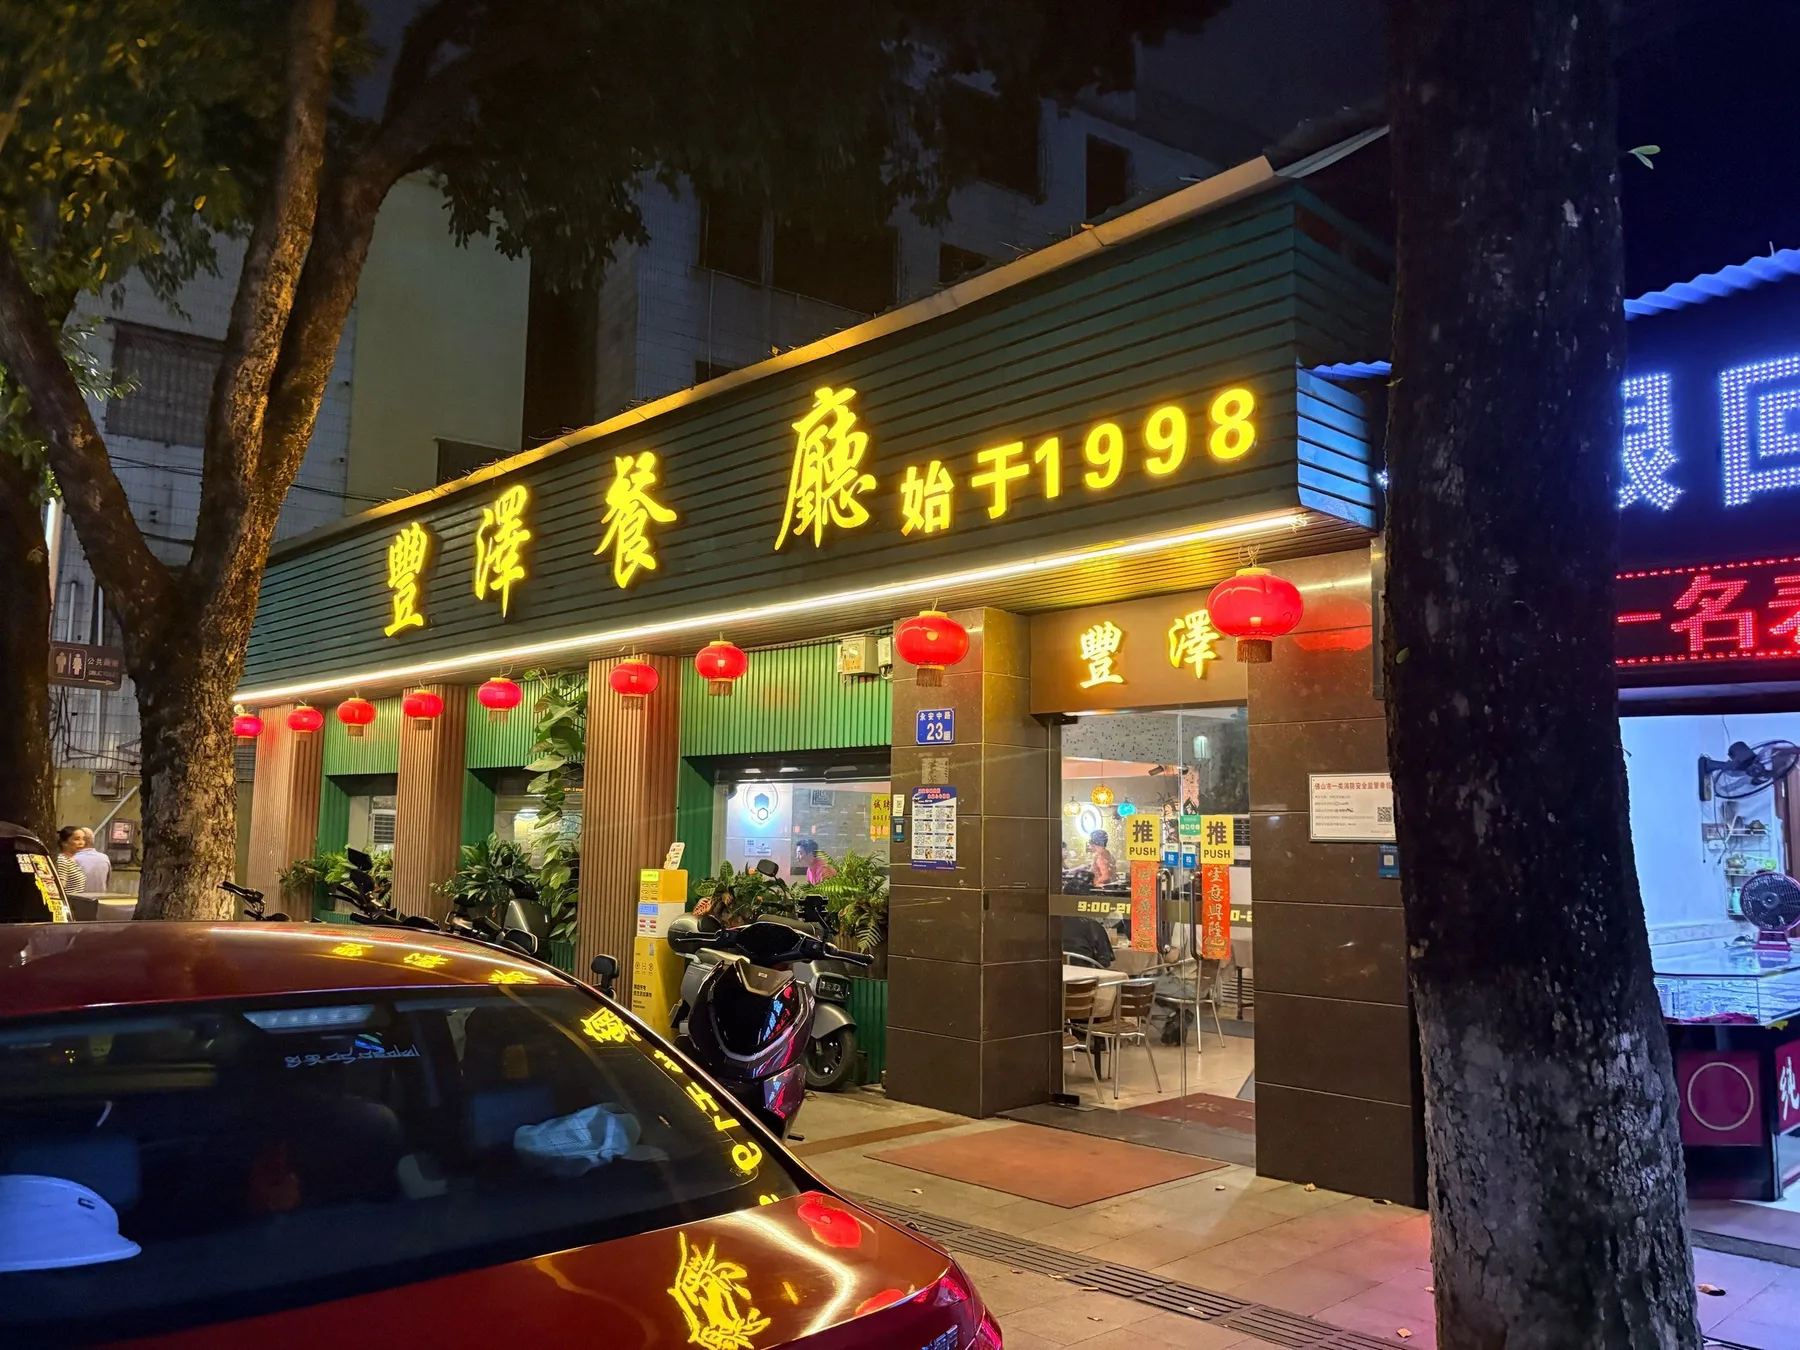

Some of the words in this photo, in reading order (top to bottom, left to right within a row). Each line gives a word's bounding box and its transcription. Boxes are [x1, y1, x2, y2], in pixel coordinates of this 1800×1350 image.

[384, 386, 877, 637] 豐澤餐廳
[900, 387, 1256, 537] 始于1998
[1079, 608, 1220, 689] 豐澤
[919, 711, 951, 721] 永安中路
[926, 722, 944, 741] 23
[1132, 819, 1154, 844] 推
[1206, 820, 1228, 846] 推
[1129, 847, 1157, 856] PUSH
[1203, 849, 1231, 859] PUSH
